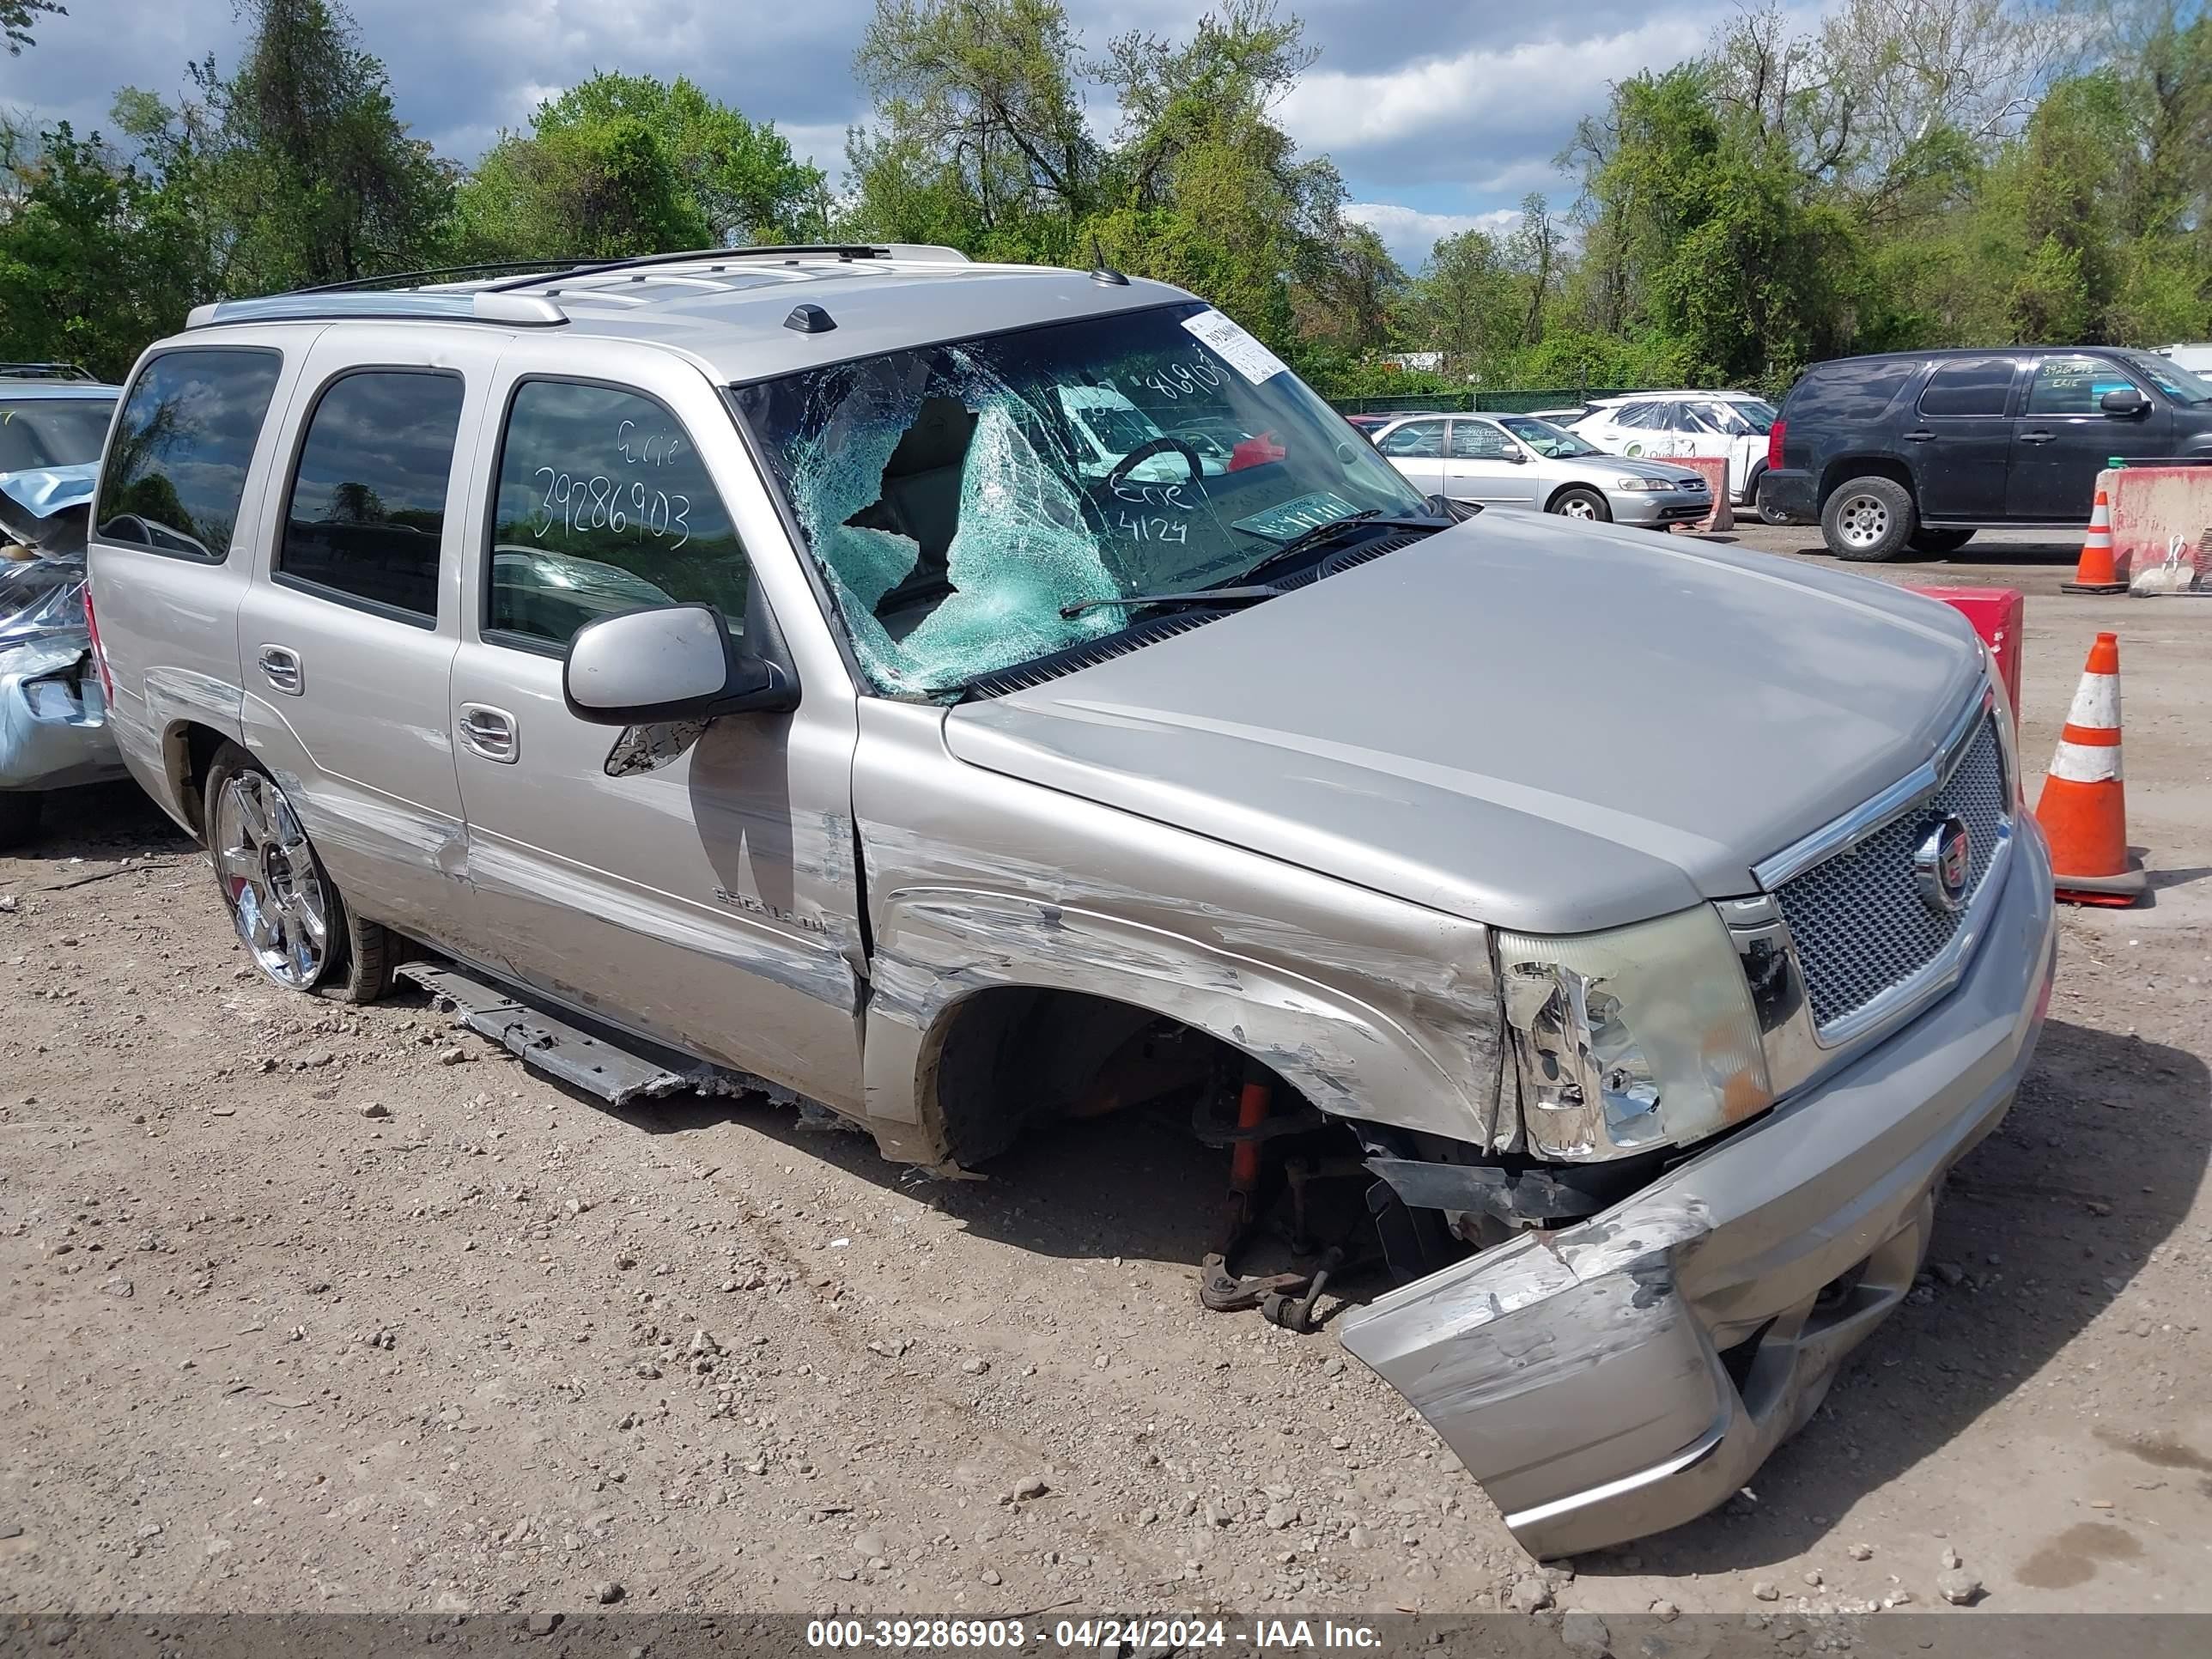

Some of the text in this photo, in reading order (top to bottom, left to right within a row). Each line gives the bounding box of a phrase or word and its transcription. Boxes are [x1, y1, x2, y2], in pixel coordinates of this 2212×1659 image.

[1146, 348, 1231, 398] 86903
[618, 420, 678, 466] Erie
[534, 466, 690, 551] 39286903
[1109, 472, 1194, 509] Erie
